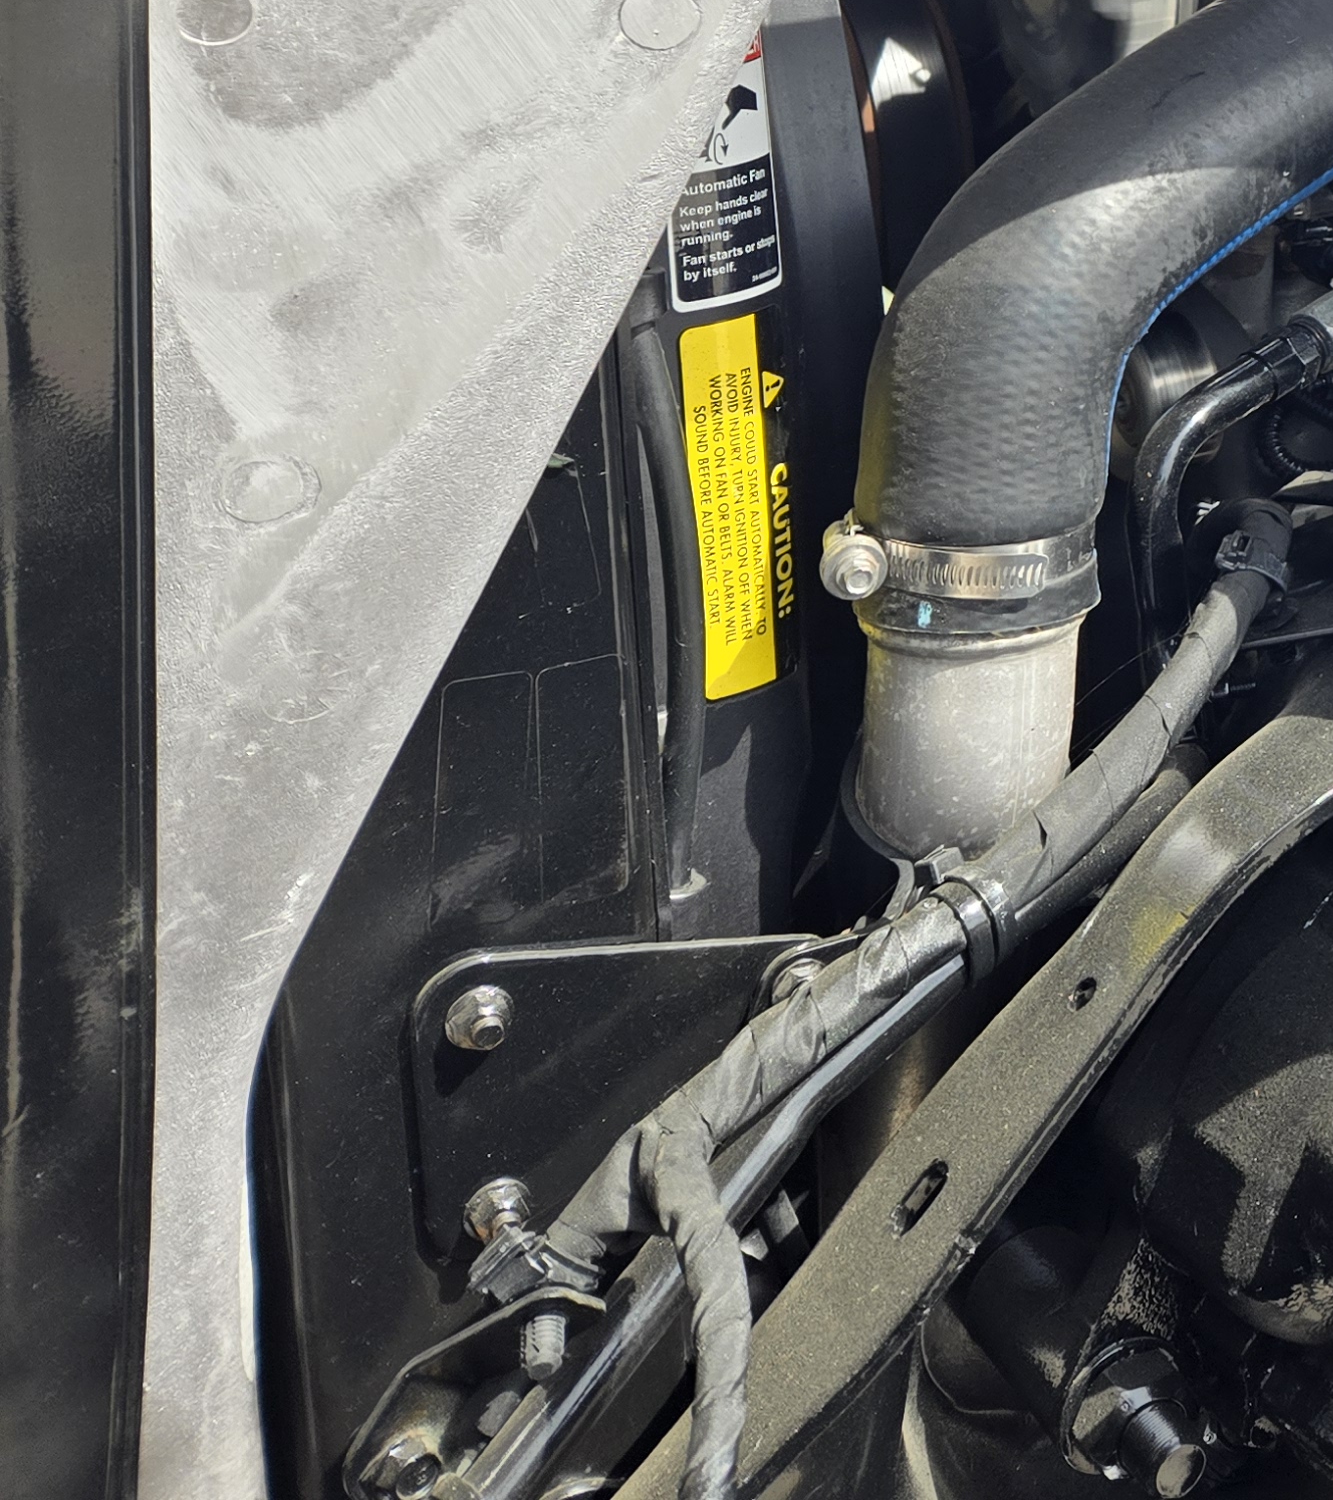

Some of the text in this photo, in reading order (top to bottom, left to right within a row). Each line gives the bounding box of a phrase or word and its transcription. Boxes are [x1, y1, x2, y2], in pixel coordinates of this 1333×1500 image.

[680, 168, 766, 197] Automatic Fan
[679, 188, 768, 218] Keep hands clear
[680, 205, 762, 232] when engine is
[680, 230, 734, 247] running.
[682, 254, 706, 267] Fan
[709, 247, 744, 263] starts
[744, 243, 756, 254] or
[683, 270, 700, 282] by
[702, 261, 737, 278] itself.
[725, 372, 739, 414] AVOID
[740, 367, 754, 417] ENGINE
[693, 405, 709, 453] SOUND
[744, 421, 757, 465] COULD
[697, 457, 713, 506] BEFORE
[732, 469, 745, 505] TURN
[747, 469, 760, 505] START
[708, 374, 737, 646] WORKING ON FAN OR BELTS. ALARM WILL
[701, 510, 718, 586] AUTOMATIC
[734, 508, 749, 569] IGNITION
[770, 462, 795, 619] CAUTION:
[738, 572, 751, 596] OFF
[740, 599, 753, 641] WHEN
[756, 617, 767, 636] TO
